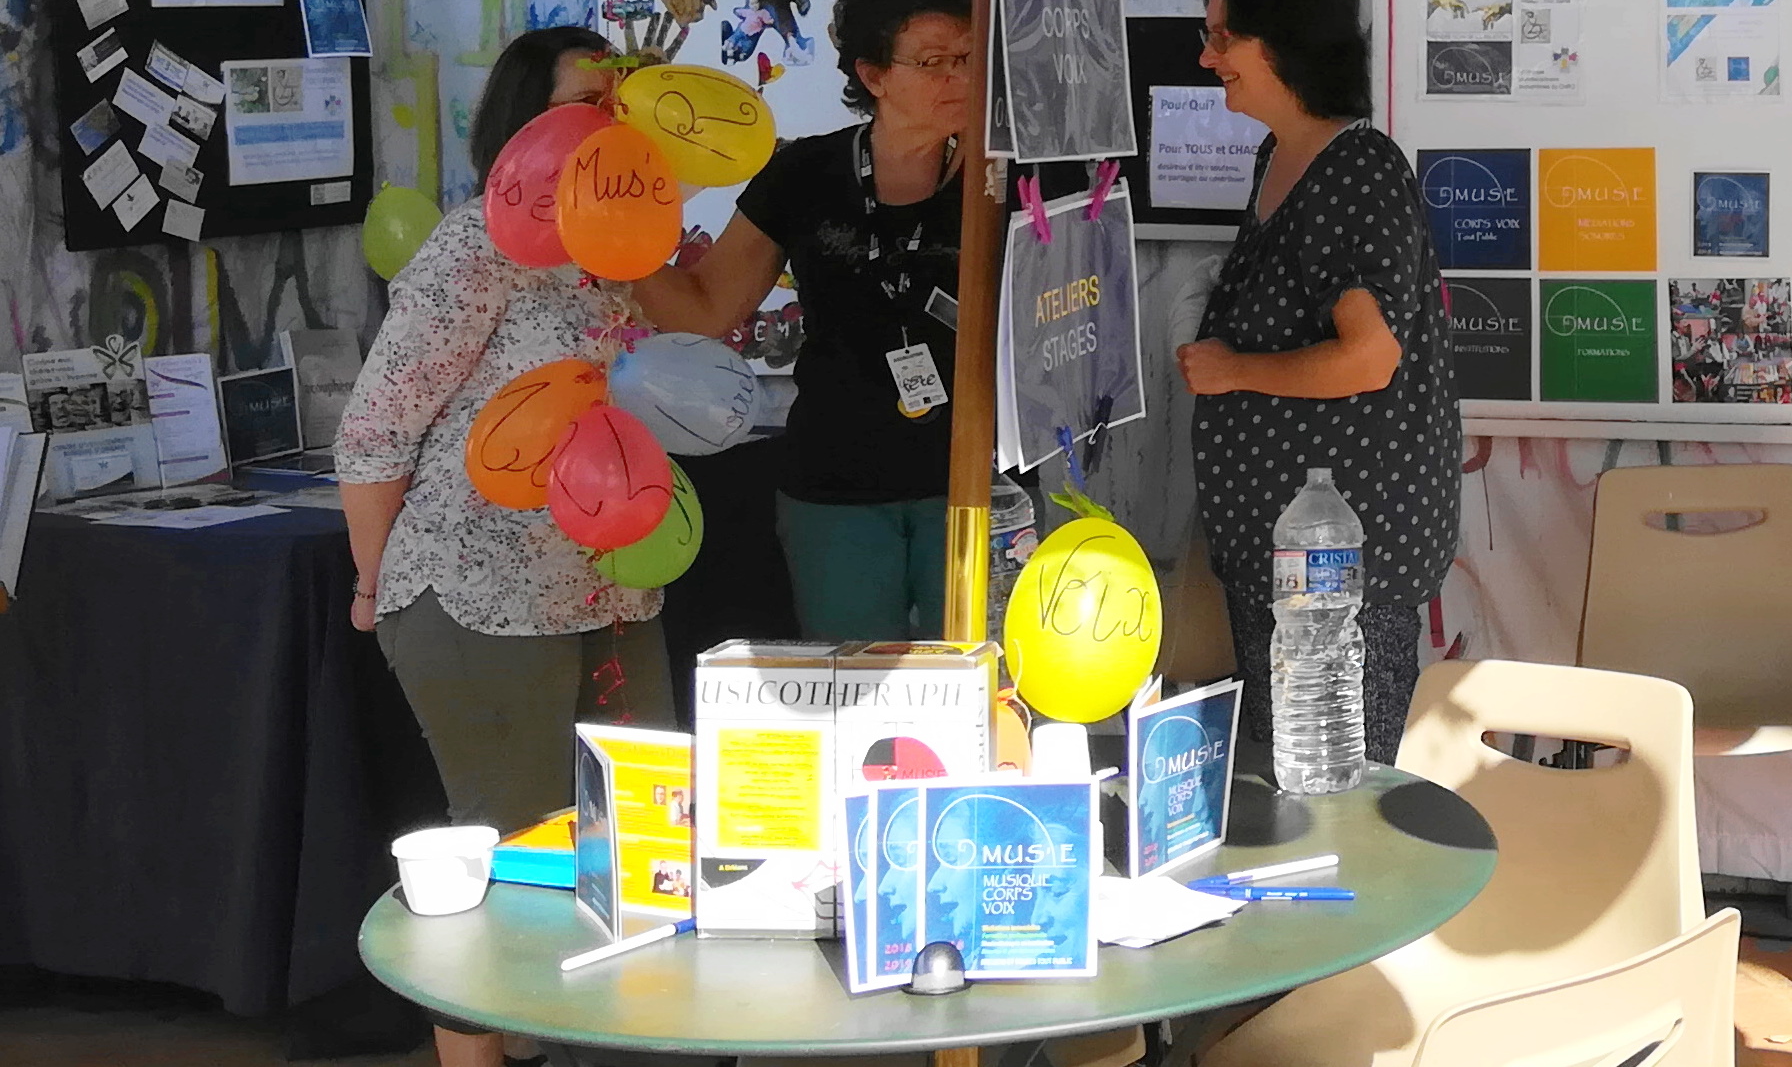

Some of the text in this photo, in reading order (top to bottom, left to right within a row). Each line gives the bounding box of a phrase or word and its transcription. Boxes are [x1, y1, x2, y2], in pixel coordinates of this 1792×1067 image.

[1041, 6, 1090, 39] CORPS
[1052, 53, 1088, 84] VOIX
[1160, 98, 1215, 112] Pour Qui?
[1158, 143, 1182, 154] Pour
[1185, 144, 1213, 154] TOUS
[1216, 144, 1226, 154] et
[1035, 274, 1101, 328] ATELIERS
[1042, 321, 1098, 372] STAGES
[983, 873, 1051, 888] MUSIQUE
[983, 887, 1033, 901] CORPS
[982, 901, 1016, 915] VOIX
